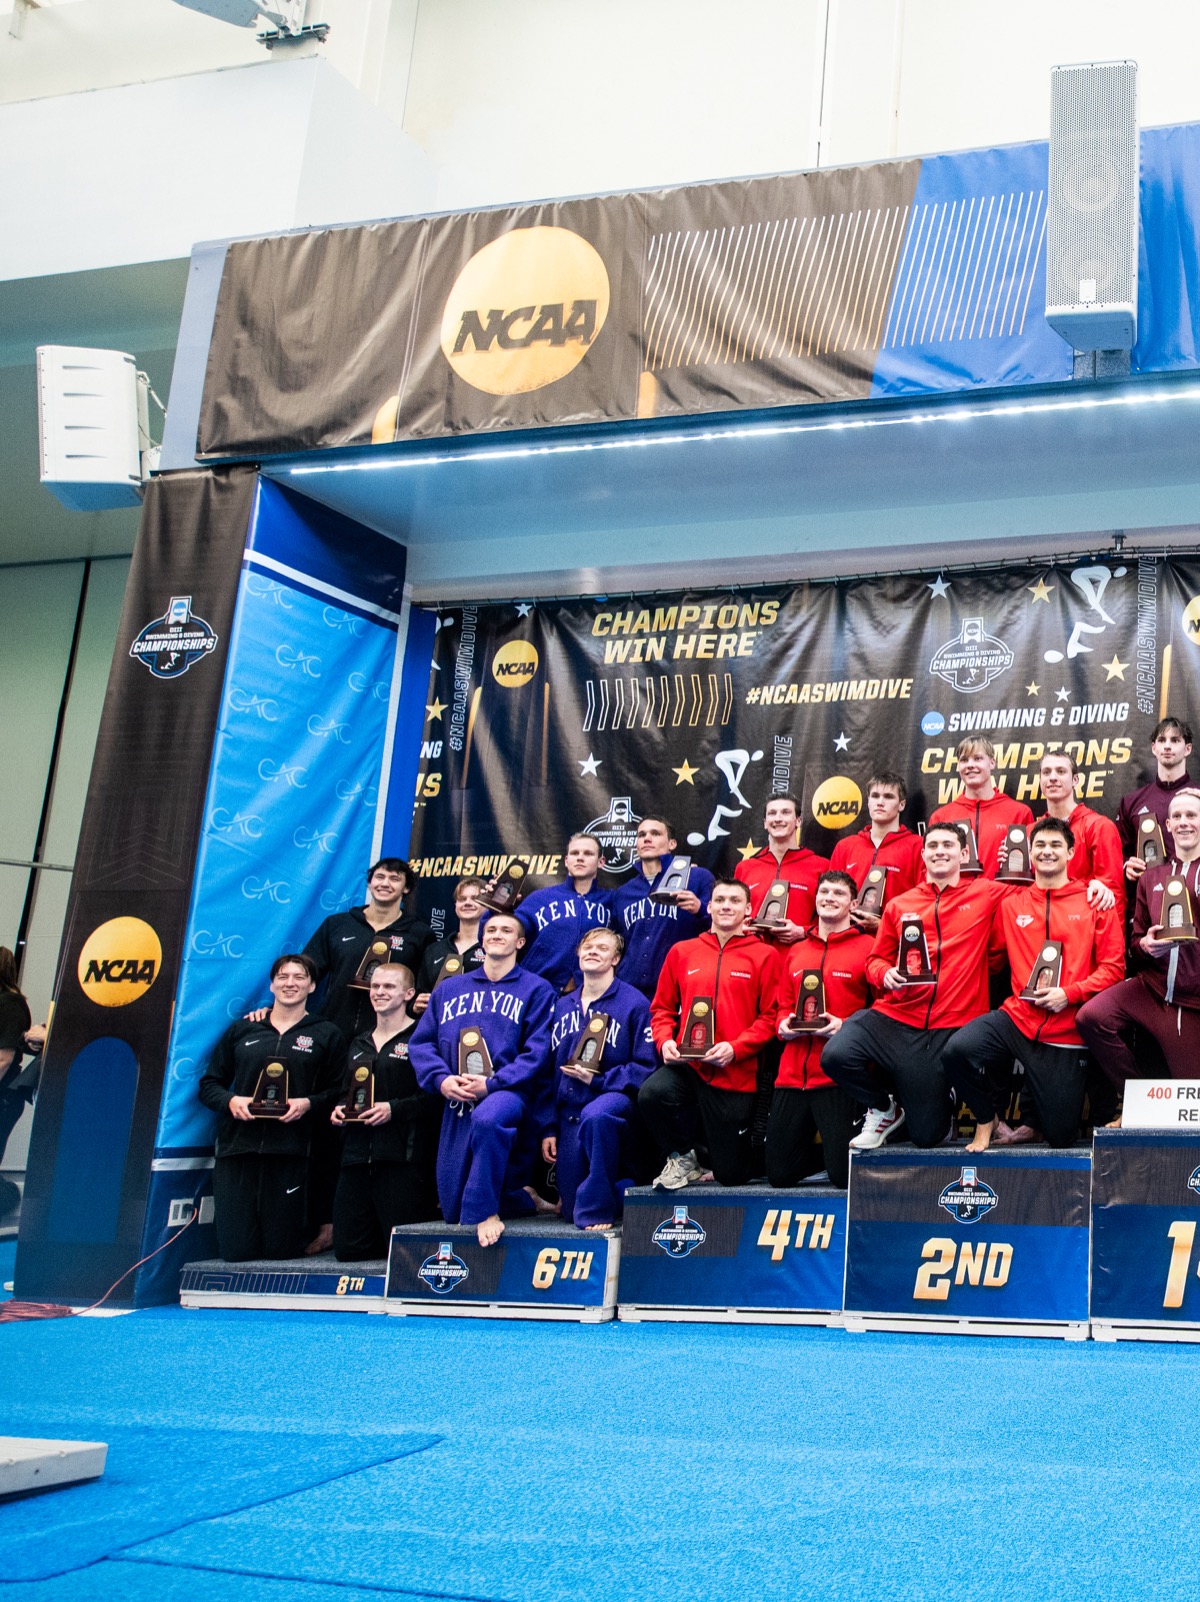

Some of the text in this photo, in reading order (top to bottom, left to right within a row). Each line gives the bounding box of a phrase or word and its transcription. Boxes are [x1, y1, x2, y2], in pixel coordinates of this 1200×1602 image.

[452, 299, 599, 356] NCAA
[592, 601, 780, 637] CHAMPIONS
[133, 638, 215, 653] CHAMPIONSHIPS
[604, 637, 667, 664] WIN
[496, 662, 536, 677] NCAA
[933, 655, 1011, 670] CHAMPIONSHIPS
[746, 678, 913, 705] #NCAASWIMDIVE
[923, 702, 1130, 732] NCAA SWIMMING & DIVING
[816, 801, 860, 816] NCAA
[83, 959, 157, 985] NCAA
[440, 990, 524, 1025] KENYON
[1146, 1086, 1172, 1101] 400
[940, 1196, 997, 1205] CHAMPIONSHIPS
[654, 1233, 704, 1241] CHAMPIONSHIPS
[757, 1209, 836, 1261] 4TH
[532, 1247, 595, 1289] 6TH
[913, 1237, 1014, 1300] 2ND
[336, 1275, 364, 1295] 8TH
